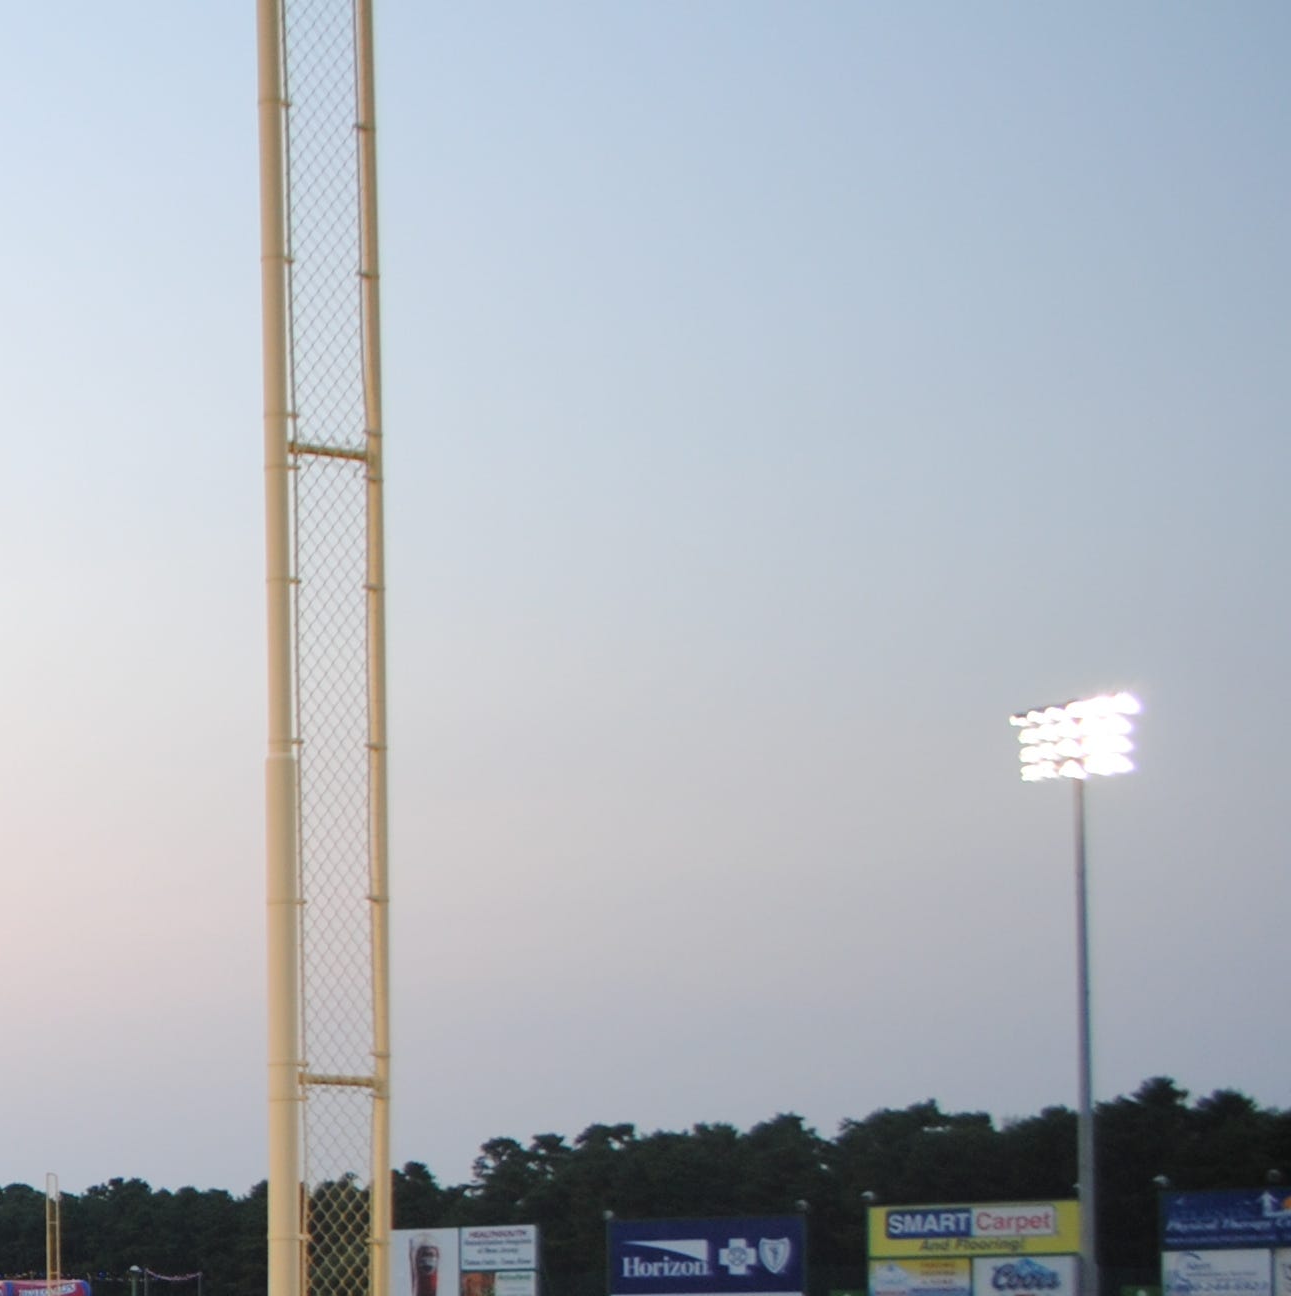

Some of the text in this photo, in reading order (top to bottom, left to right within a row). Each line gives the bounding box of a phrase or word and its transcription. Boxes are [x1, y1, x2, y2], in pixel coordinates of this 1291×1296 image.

[888, 1208, 1051, 1234] SMART Carpet
[920, 1238, 950, 1251] And
[622, 1256, 708, 1277] Horizon
